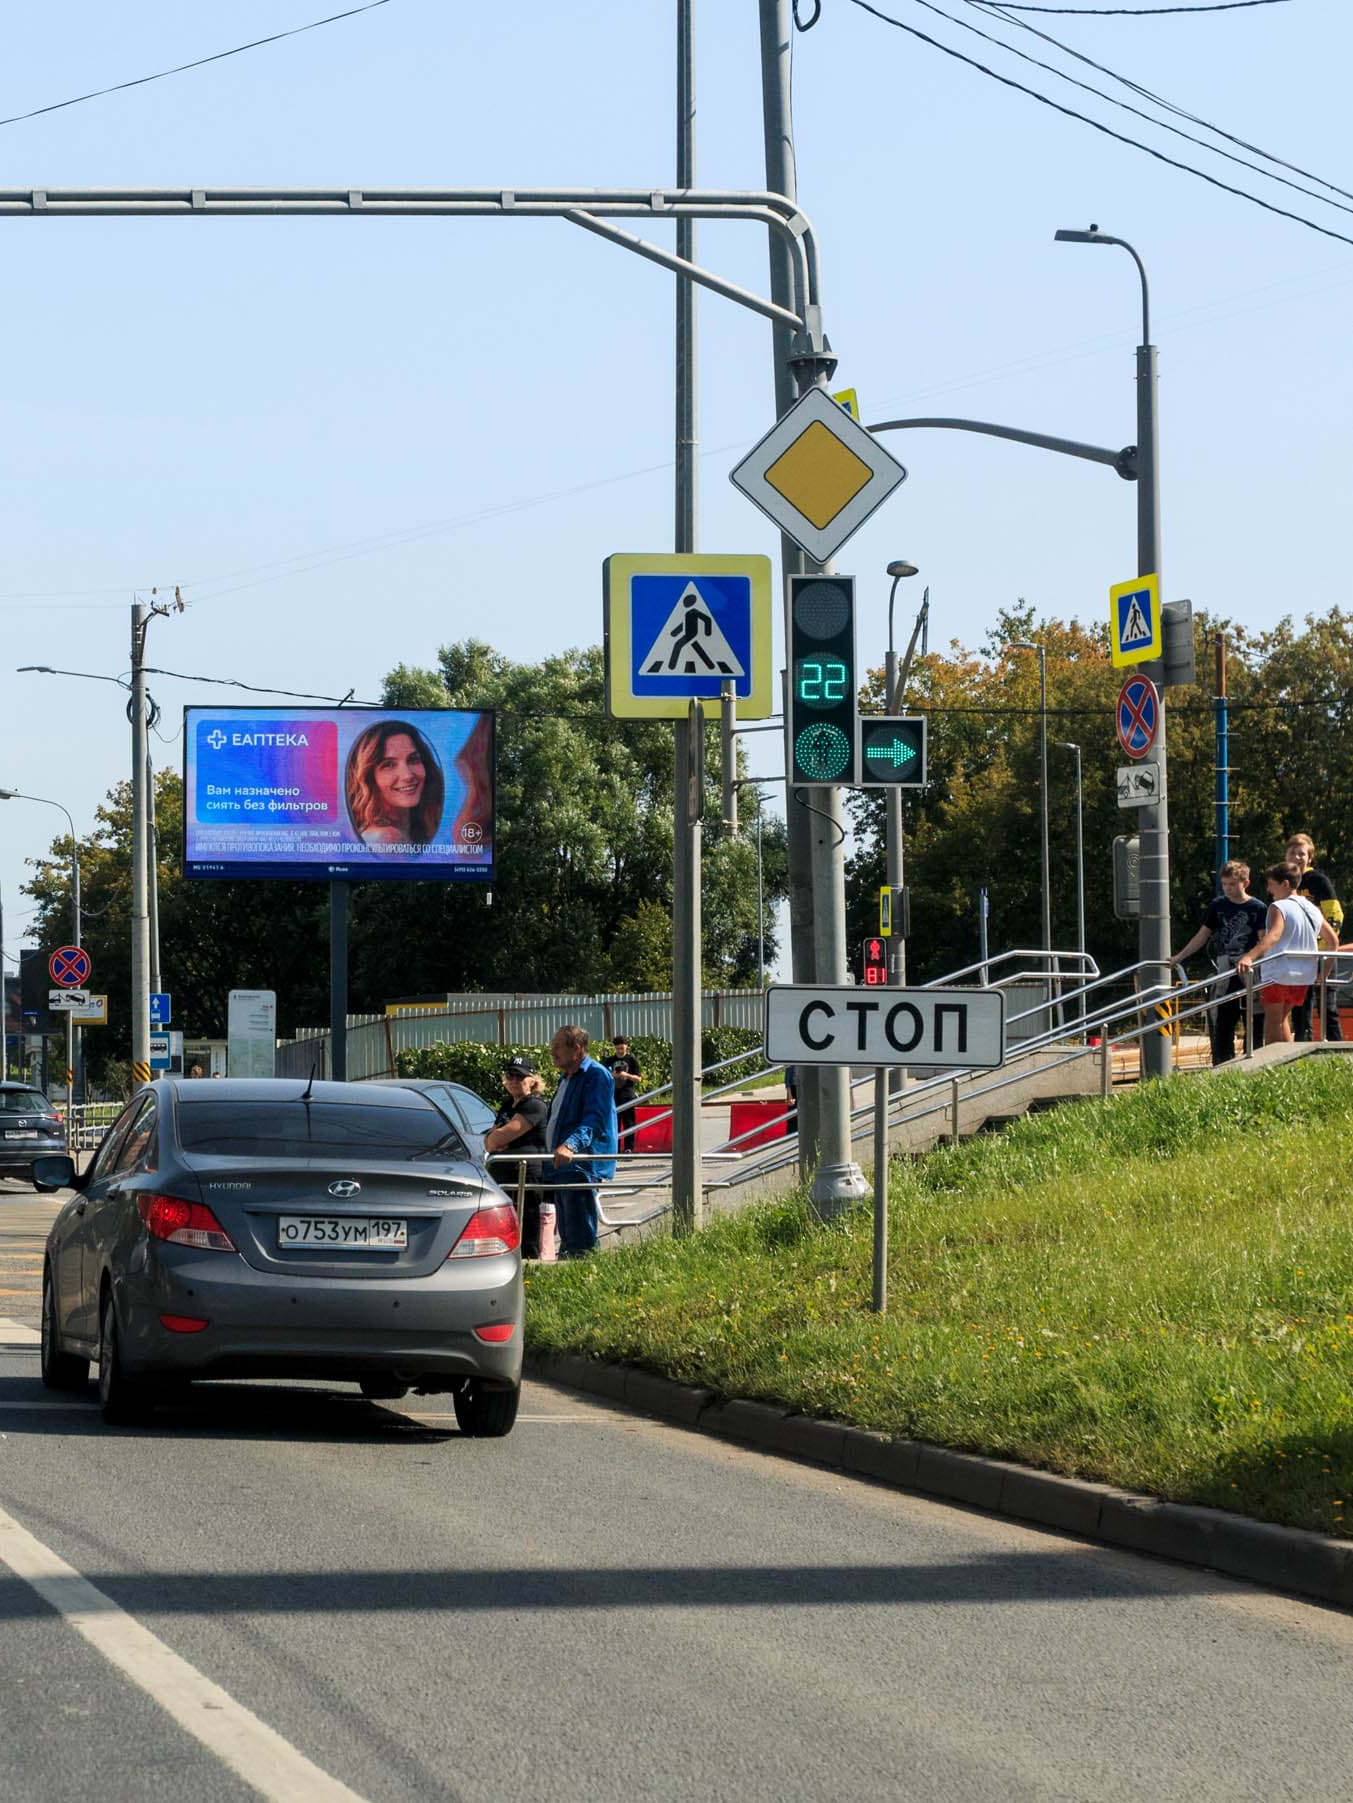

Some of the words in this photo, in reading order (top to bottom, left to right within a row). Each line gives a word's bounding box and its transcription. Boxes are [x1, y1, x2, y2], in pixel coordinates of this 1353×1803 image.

[800, 663, 846, 699] 22
[232, 733, 309, 747] ЕАПТЕКА
[207, 785, 231, 796] Вам
[234, 787, 300, 796] назначено
[206, 801, 241, 810] сиять
[243, 799, 265, 810] без
[268, 799, 328, 813] фильтров
[462, 827, 482, 838] 18+
[867, 967, 886, 984] 81
[799, 1000, 968, 1053] СТОП
[285, 1220, 368, 1242] О753УМ
[372, 1221, 402, 1238] 197
